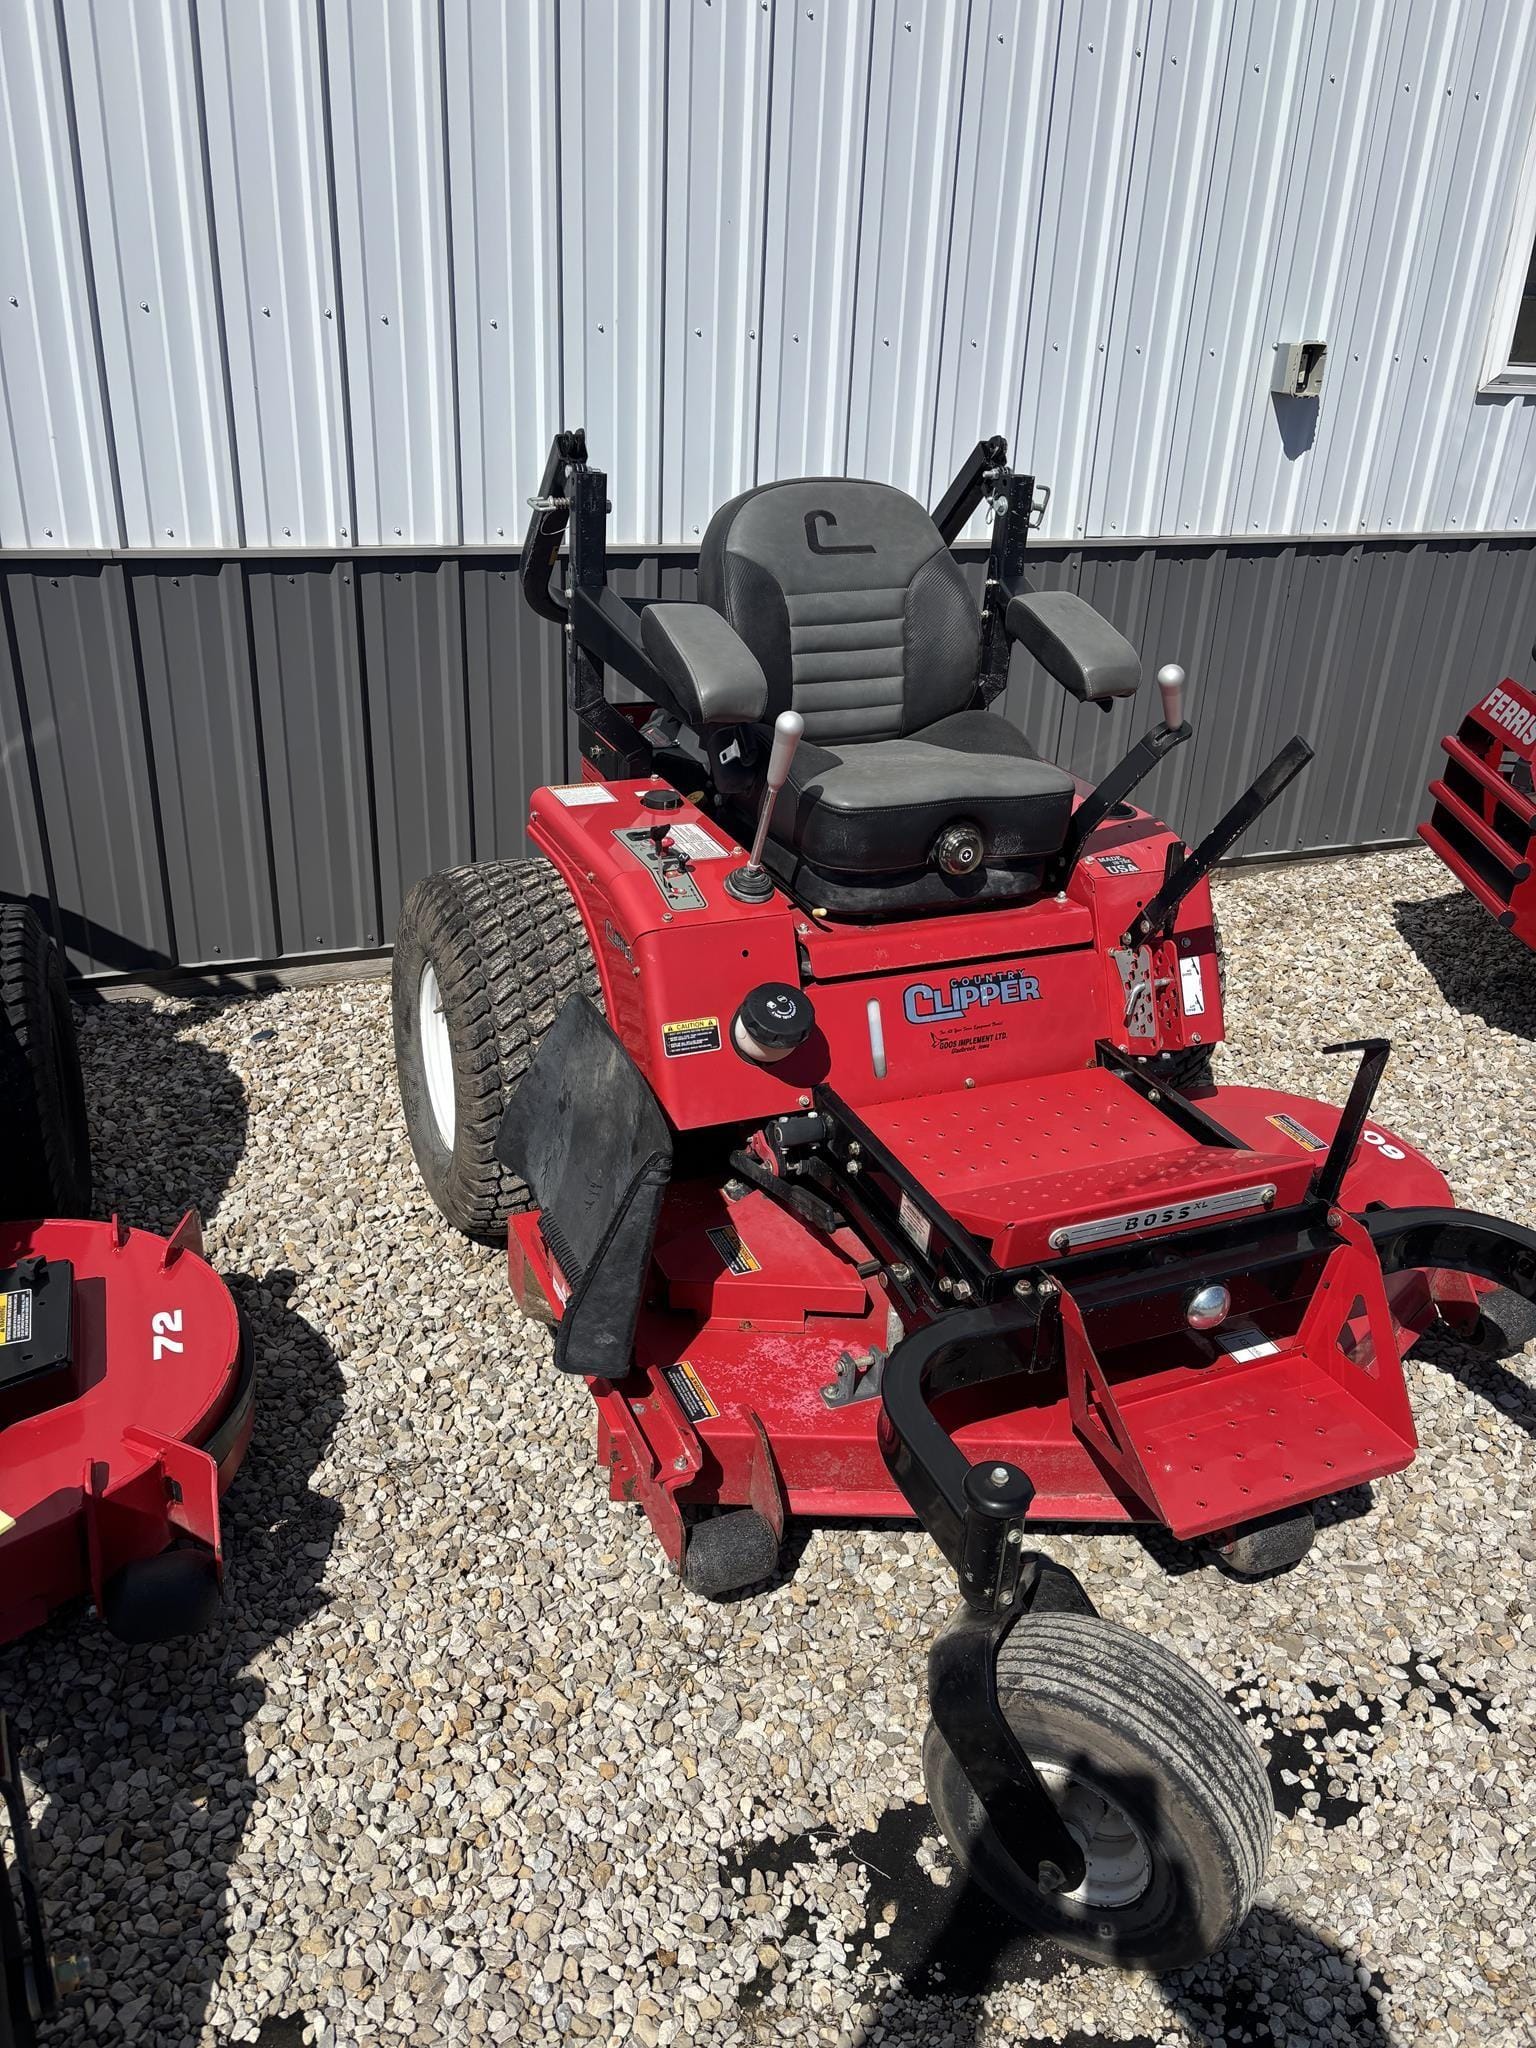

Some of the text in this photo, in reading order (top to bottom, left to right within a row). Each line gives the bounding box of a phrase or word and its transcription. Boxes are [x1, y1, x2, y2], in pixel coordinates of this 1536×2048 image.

[1106, 863, 1141, 874] USA
[950, 968, 1025, 987] COUNTRY
[903, 974, 1043, 1025] CLIPPER
[676, 1020, 705, 1030] CAUTION
[958, 1034, 994, 1047] IMPLEMENT
[1124, 1201, 1209, 1231] BOSS XL
[152, 1309, 184, 1361] 72
